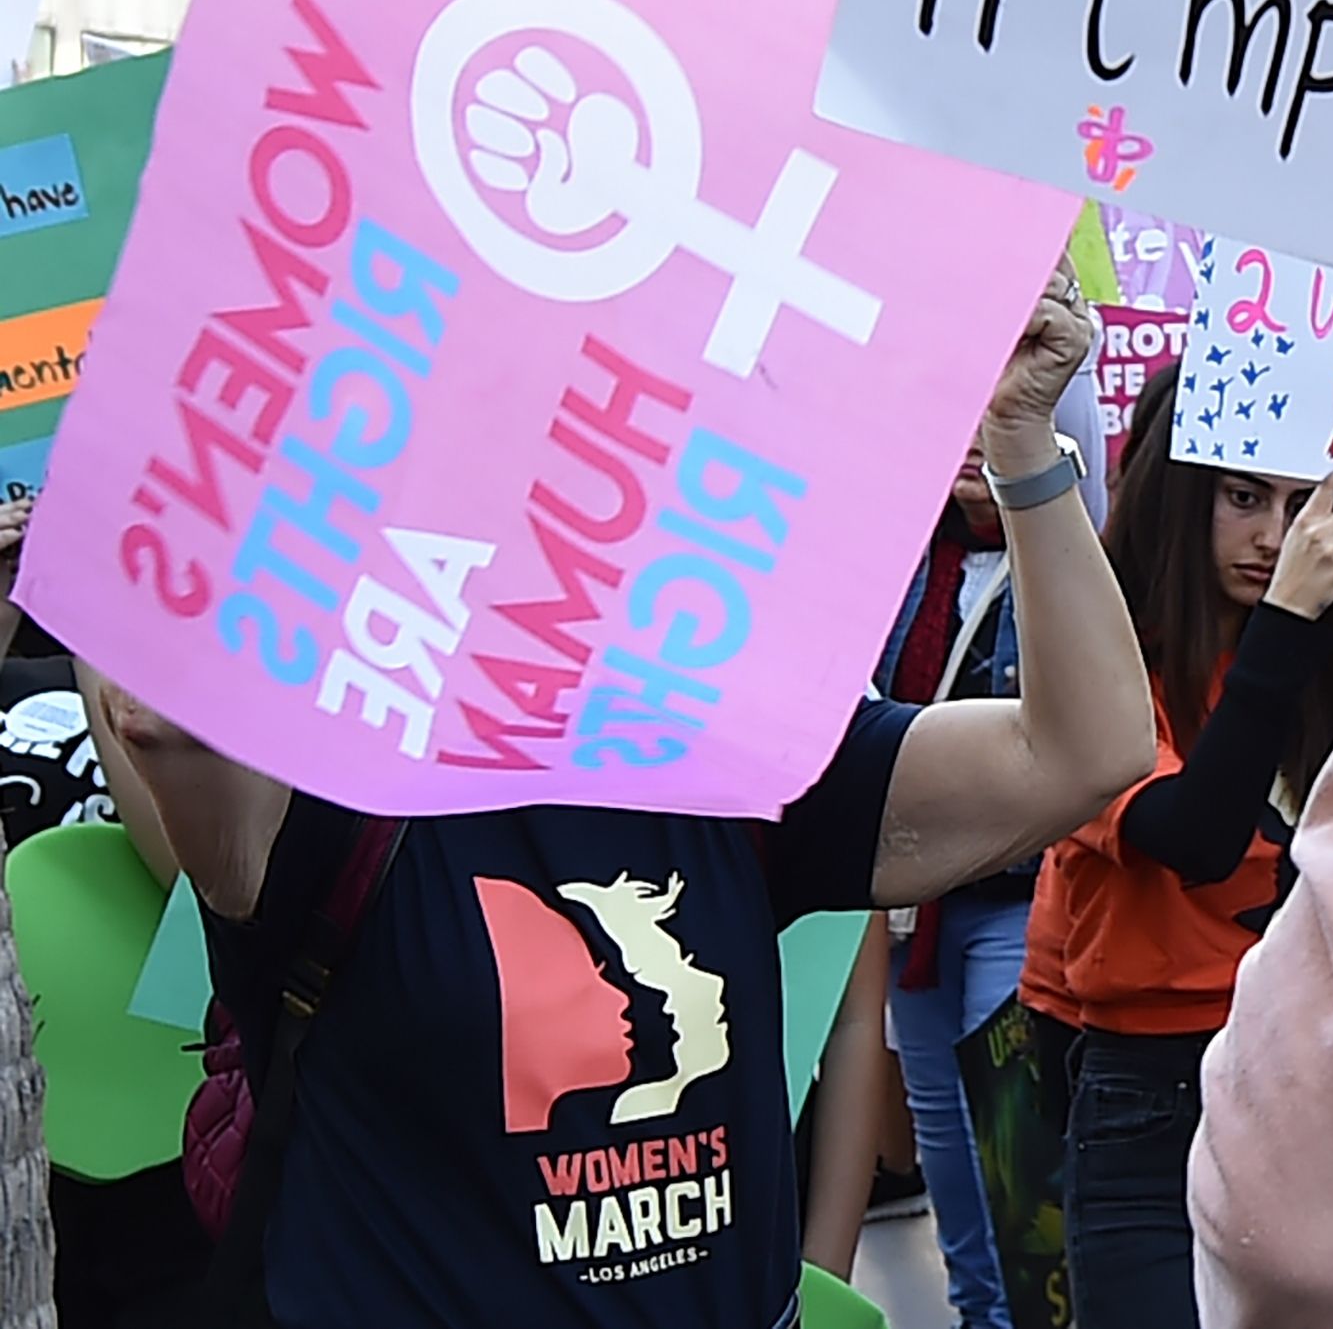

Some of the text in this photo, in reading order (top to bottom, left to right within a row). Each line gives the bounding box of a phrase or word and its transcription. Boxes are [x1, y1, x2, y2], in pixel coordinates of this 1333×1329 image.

[1, 182, 79, 220] have
[1227, 248, 1287, 334] 2
[1105, 323, 1188, 358] ROT
[536, 1125, 729, 1196] WOMEN'S
[534, 1169, 732, 1264] MARCH
